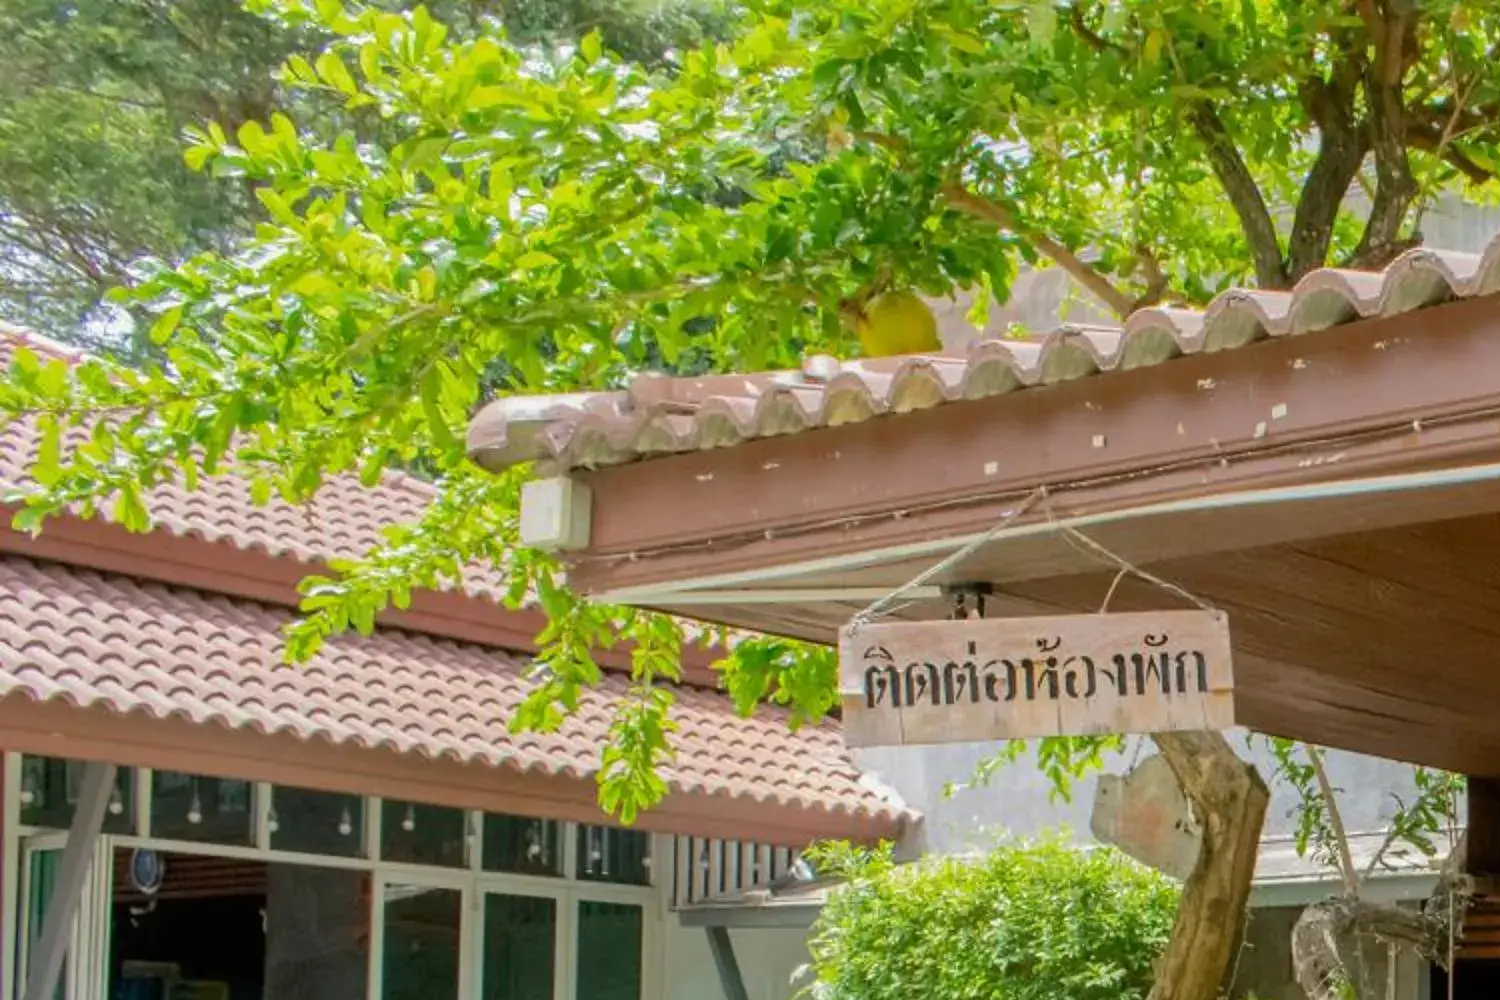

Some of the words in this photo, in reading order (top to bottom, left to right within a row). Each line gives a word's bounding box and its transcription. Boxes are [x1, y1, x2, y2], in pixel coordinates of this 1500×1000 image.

[863, 633, 1208, 708] ติดต่อห้องพัก
